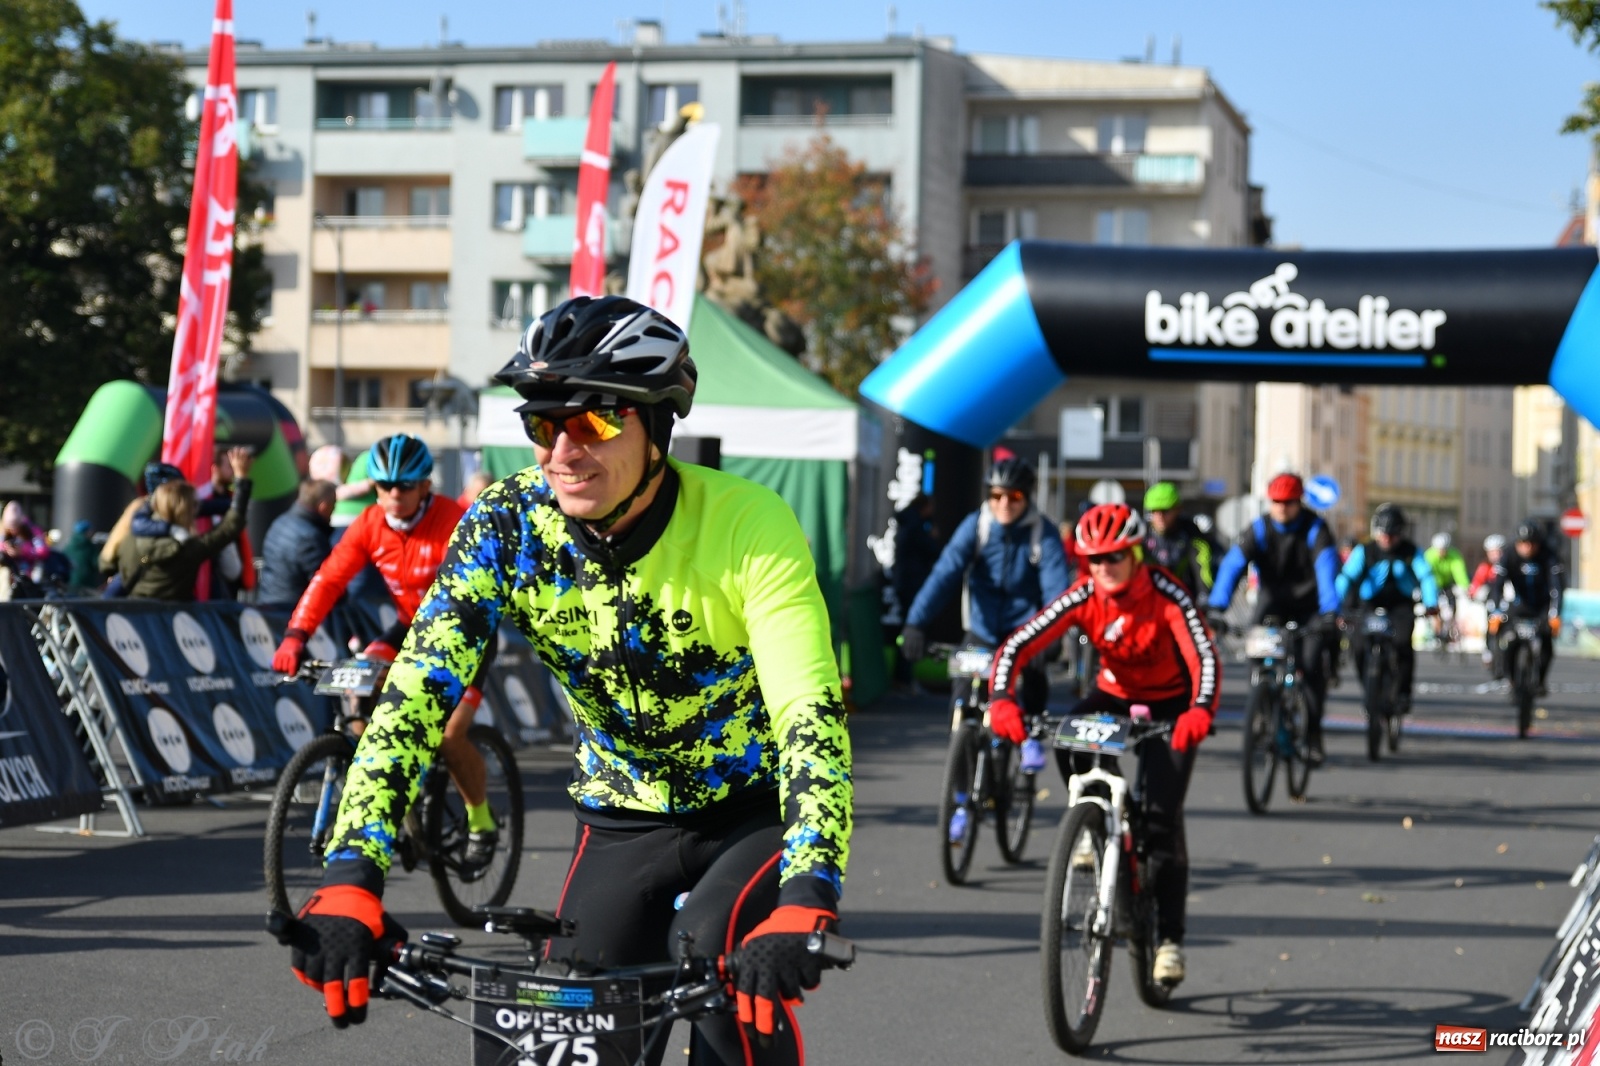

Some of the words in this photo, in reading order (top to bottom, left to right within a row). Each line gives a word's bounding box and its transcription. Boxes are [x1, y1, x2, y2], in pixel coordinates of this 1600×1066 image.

[1144, 290, 1259, 346] bike
[1270, 294, 1447, 350] atelier
[555, 627, 578, 637] Bike
[495, 1008, 615, 1033] OPIEKUN
